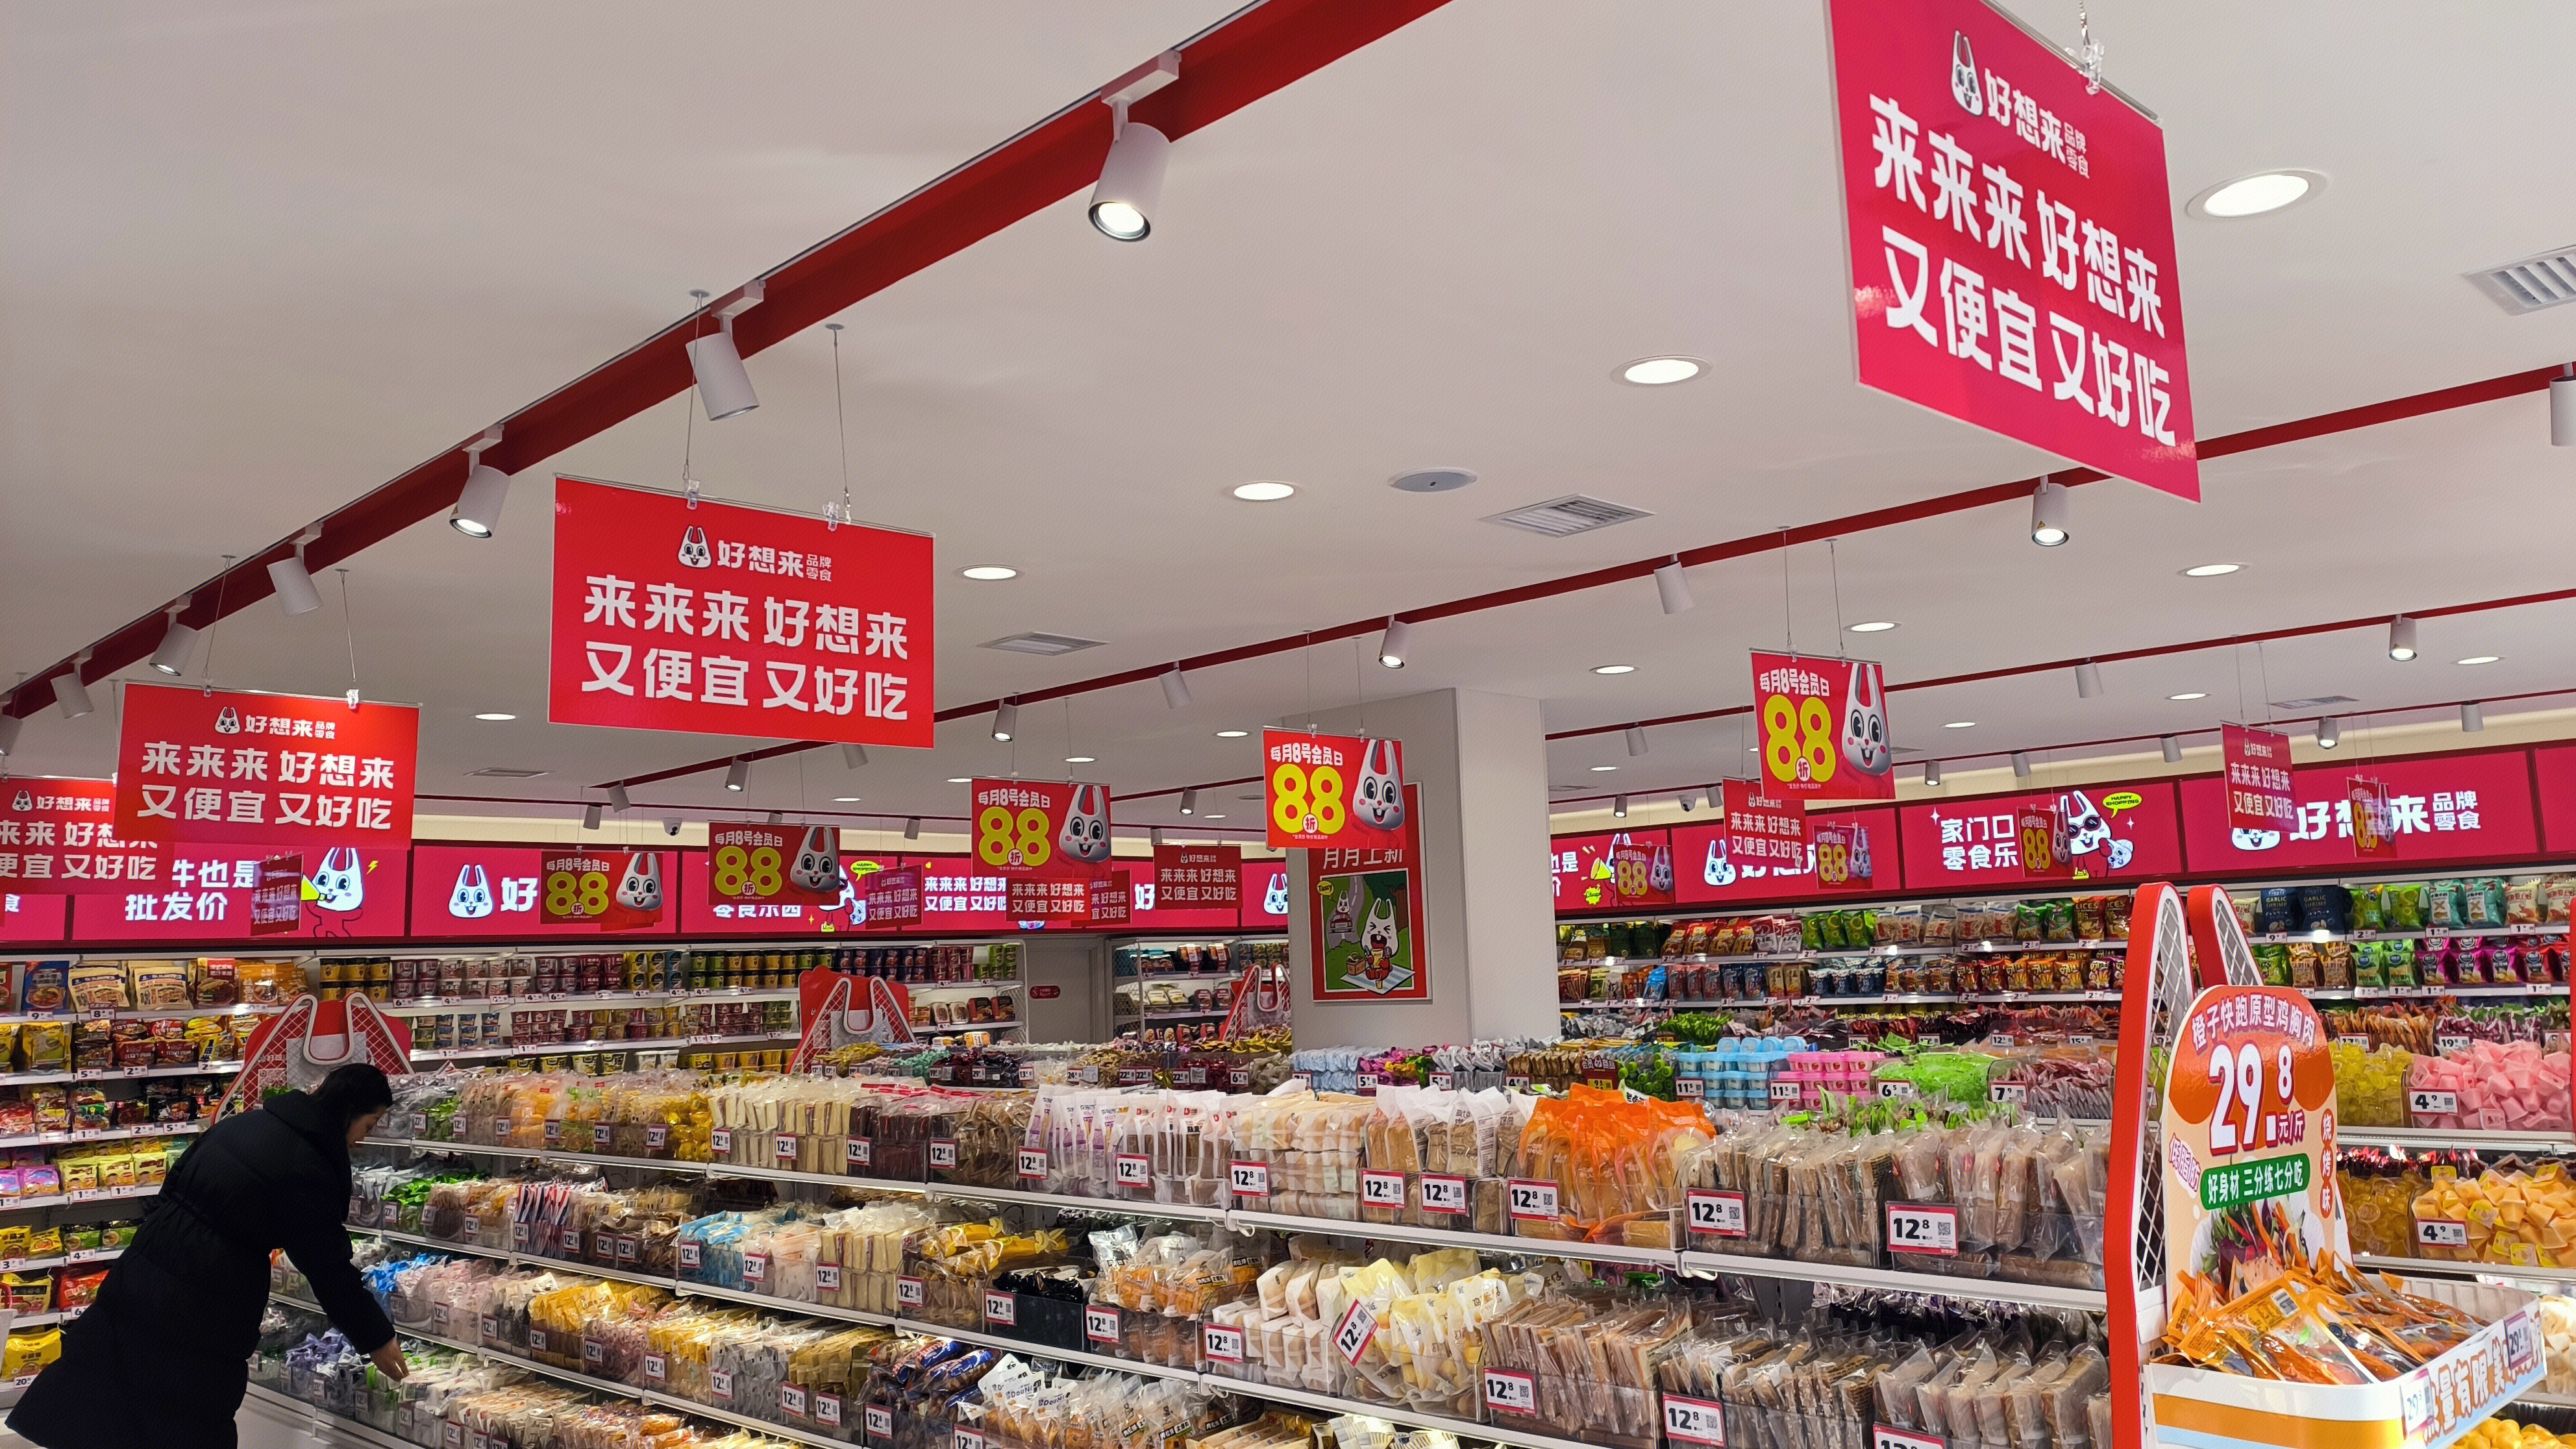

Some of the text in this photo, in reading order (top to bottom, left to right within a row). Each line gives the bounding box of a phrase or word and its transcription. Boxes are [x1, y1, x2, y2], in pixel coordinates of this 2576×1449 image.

[1985, 68, 2065, 164] 好想来
[1870, 93, 2165, 338] 来来来 好想来
[1883, 225, 2175, 447] 又便宜 又好吃
[717, 540, 832, 578] 好想来 品牌
[806, 567, 832, 582] 零食
[584, 575, 907, 660] 来来来 好想来
[582, 641, 908, 720] 又便宜 又好吃
[1760, 668, 1830, 697] 每月8号会员日
[245, 715, 314, 737] 好想来
[142, 741, 395, 789] 来来来 好想来
[1270, 743, 1343, 766] 每月8号会员日
[2231, 762, 2290, 791] 来来来 好想来
[36, 796, 92, 811] 好想来
[137, 784, 393, 830] 又便宜 又好吃
[978, 789, 1050, 808] 每月8号会员日
[2234, 791, 2293, 819] 又便宜 又好吃
[2433, 791, 2479, 811] 品牌
[1731, 812, 1801, 836] 来来来 好想来
[1940, 815, 2015, 843] 家门口
[2434, 811, 2481, 831] 零食
[64, 822, 158, 848] 好想
[715, 831, 782, 847] 每月8号会员日
[1733, 836, 1802, 860] 又便宜 又好吃
[1942, 842, 2018, 871] 零食乐
[61, 854, 156, 880] 又好吃
[546, 858, 610, 871] 每月8号会员日
[1161, 869, 1235, 883] 来来来 好想来
[501, 878, 538, 912] 好
[924, 876, 967, 892] 来来来
[1012, 884, 1048, 897] 来来来
[1050, 884, 1085, 897] 好想来
[1161, 887, 1236, 900] 又便宜 又好吃
[125, 892, 227, 921] 批发价
[869, 889, 917, 905] 来来来 好想来
[924, 897, 967, 911] 又便宜
[1012, 900, 1085, 913] 又便宜 又好吃
[1100, 891, 1126, 903] 好想来
[869, 905, 917, 921] 又便宜 又好吃
[1102, 906, 1126, 919] 又好吃
[2192, 994, 2315, 1050] 橙子快跑原型鸡胸肉
[2322, 1112, 2333, 1211] 烧烤味
[2208, 1159, 2303, 1204] 好身材 三分练七分吃
